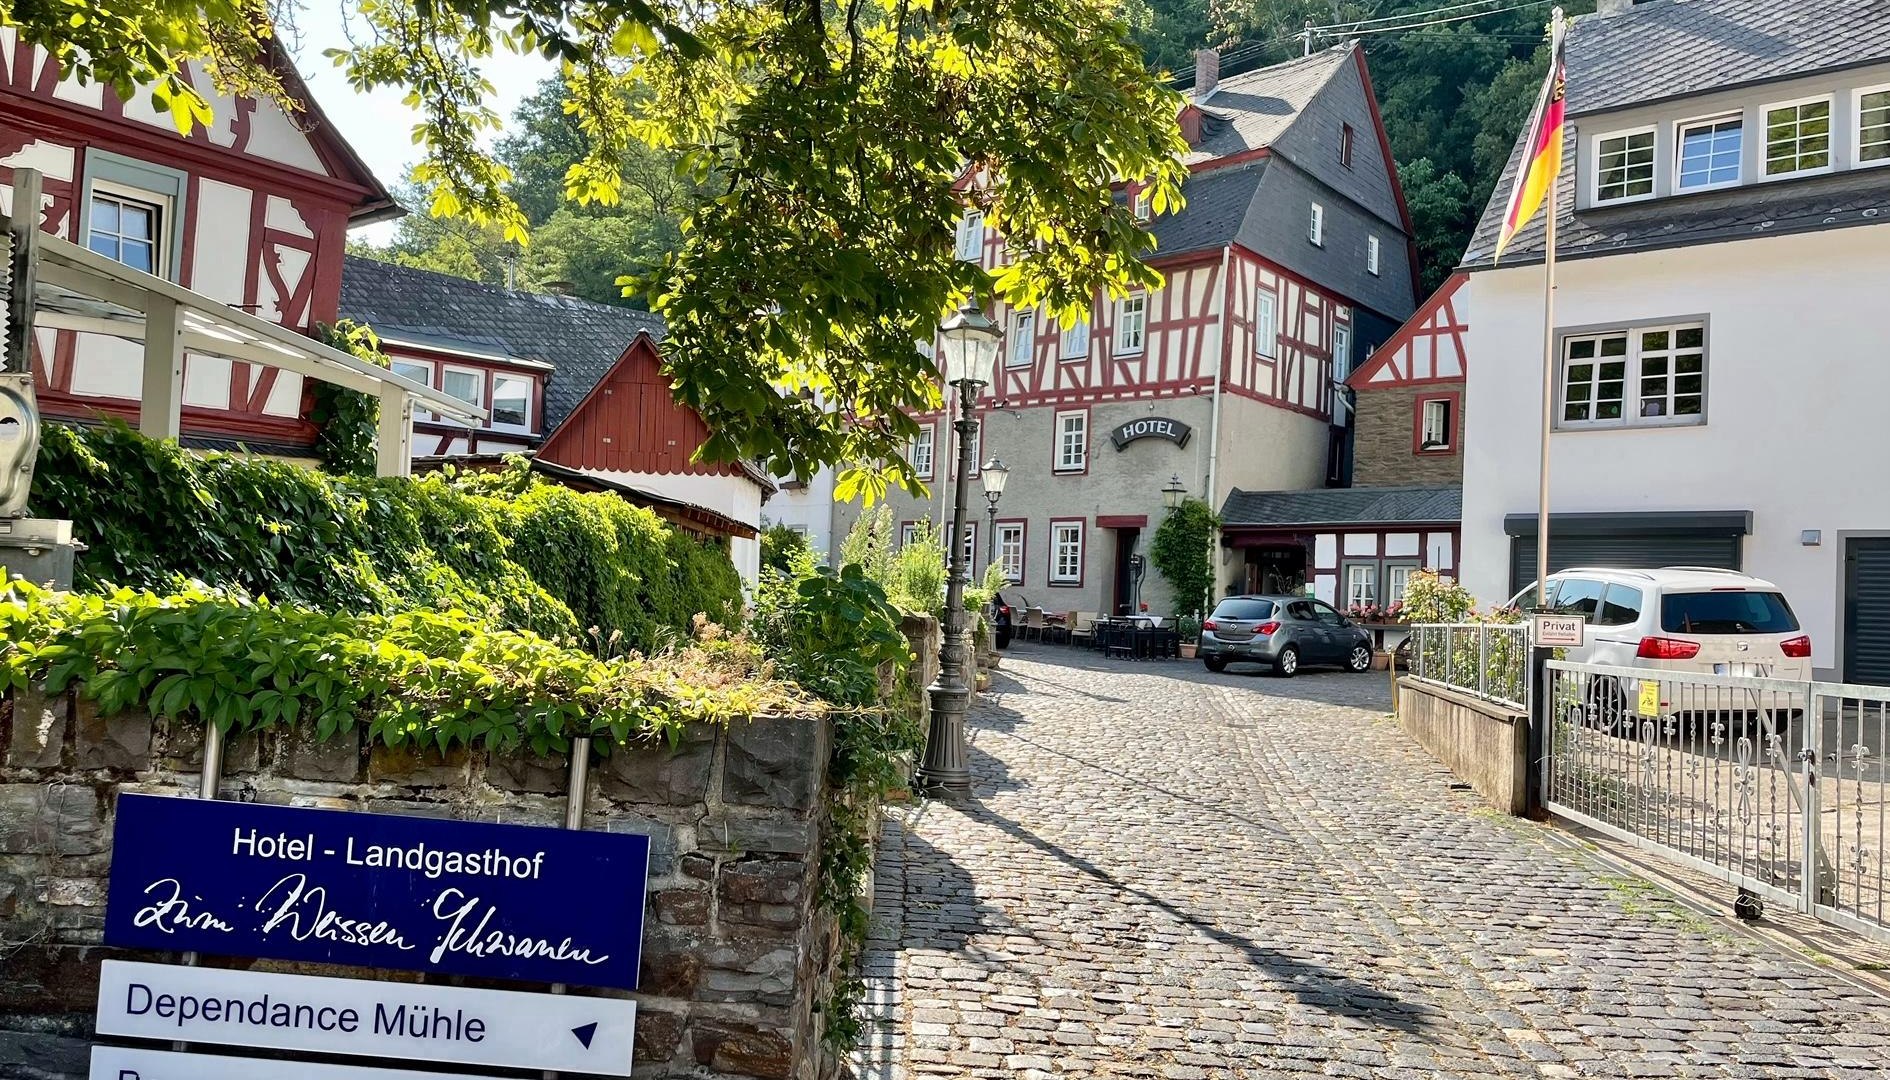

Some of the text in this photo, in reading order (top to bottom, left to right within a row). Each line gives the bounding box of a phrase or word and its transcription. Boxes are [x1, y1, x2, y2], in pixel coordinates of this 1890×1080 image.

[1122, 420, 1176, 439] HOTEL
[1543, 620, 1576, 631] Privat
[232, 827, 314, 861] Hotel
[346, 836, 545, 879] Landgasthof
[254, 873, 417, 950] Weissen
[429, 887, 609, 965] Schwanen
[126, 983, 486, 1043] Dependance Mühle
